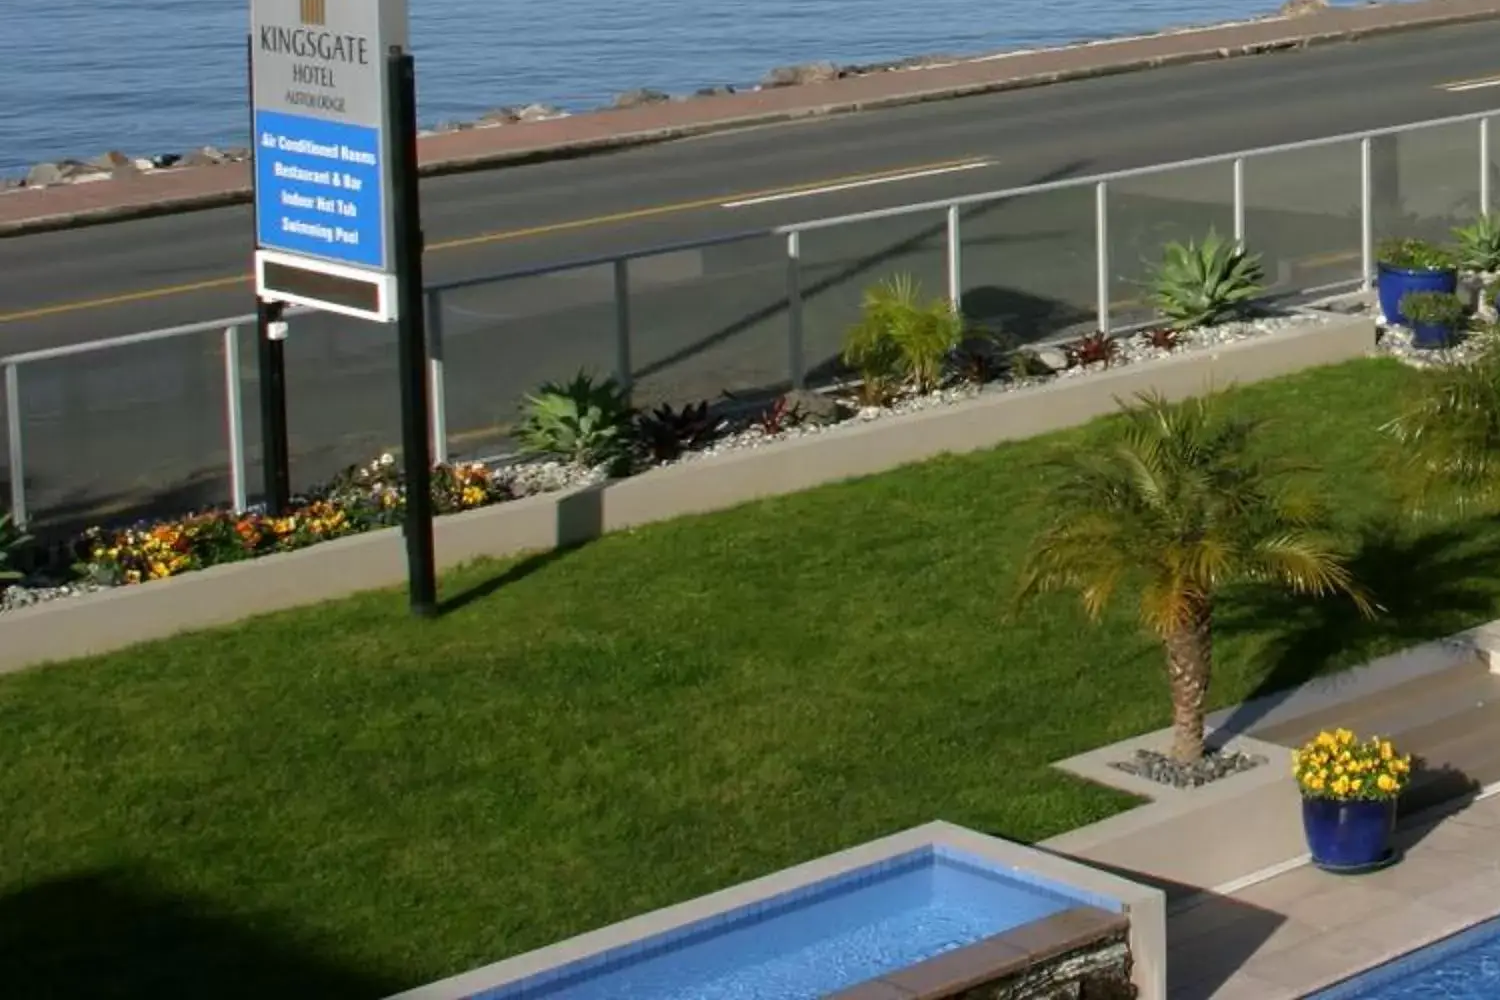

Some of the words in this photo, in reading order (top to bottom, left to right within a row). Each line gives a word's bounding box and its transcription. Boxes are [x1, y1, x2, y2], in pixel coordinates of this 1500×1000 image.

[260, 25, 369, 65] KINGSGATE
[292, 63, 336, 88] HOTEL
[261, 131, 277, 148] Air
[278, 135, 339, 159] Conditioned
[341, 145, 377, 166] Rooms
[274, 161, 330, 185] Restaurant
[332, 171, 341, 187] &
[342, 173, 363, 191] Bar
[281, 189, 315, 209] Indoor
[316, 195, 335, 213] Hot
[336, 199, 357, 217] Tub
[281, 216, 333, 243] Swimming
[335, 227, 359, 245] Pool
